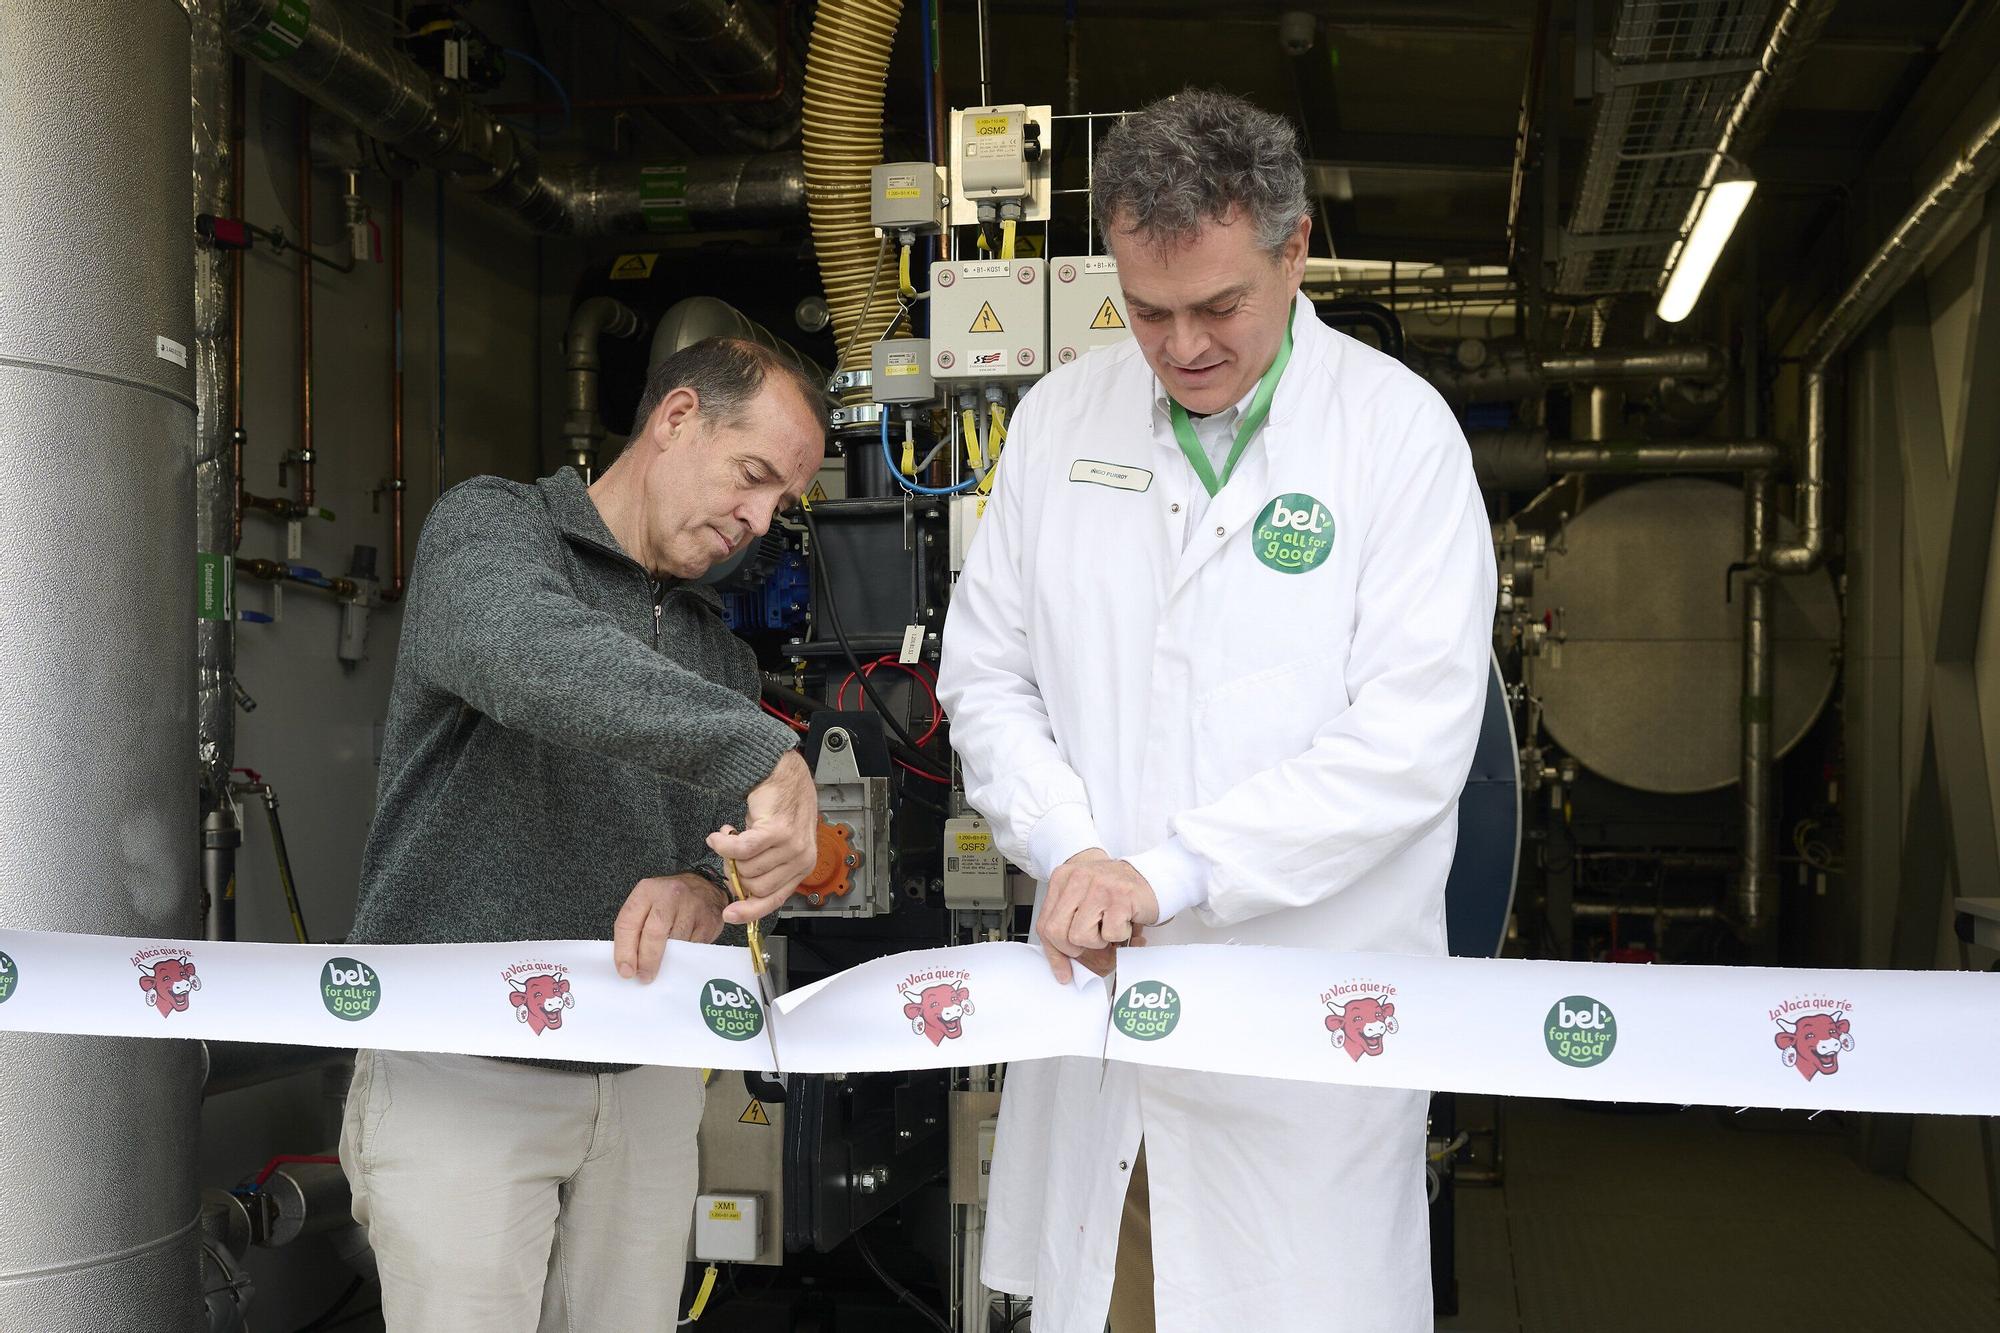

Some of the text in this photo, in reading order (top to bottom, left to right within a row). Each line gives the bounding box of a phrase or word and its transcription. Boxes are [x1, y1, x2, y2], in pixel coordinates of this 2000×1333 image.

[977, 126, 1006, 136] -QSM2
[1271, 498, 1322, 534] bel
[1258, 525, 1327, 548] for all for
[1263, 541, 1318, 564] good
[958, 843, 985, 852] -QSF3
[130, 956, 140, 967] La
[136, 949, 160, 960] Vaca
[160, 947, 178, 956] que
[329, 962, 370, 986] bel
[501, 970, 512, 981] La
[508, 963, 533, 975] Vaca
[534, 963, 553, 971] que
[896, 981, 908, 994] La
[905, 971, 933, 985] Vaca
[935, 969, 954, 979] que
[325, 984, 376, 999] for all for
[708, 983, 751, 1009] bel
[1128, 986, 1170, 1009] bel
[1319, 992, 1332, 1005] La
[1329, 983, 1358, 997] Vaca
[1359, 983, 1380, 993] que
[333, 996, 370, 1011] good
[705, 1004, 759, 1020] for all for
[1768, 1008, 1782, 1021] La
[1778, 998, 1810, 1013] Vaca
[1812, 998, 1834, 1009] que
[1118, 1007, 1175, 1021] for all for
[1558, 1001, 1605, 1030] bel
[715, 1017, 755, 1031] good
[1124, 1017, 1168, 1033] good
[1549, 1026, 1611, 1044] for all for
[1557, 1040, 1604, 1057] good
[715, 1201, 736, 1210] -XM1
